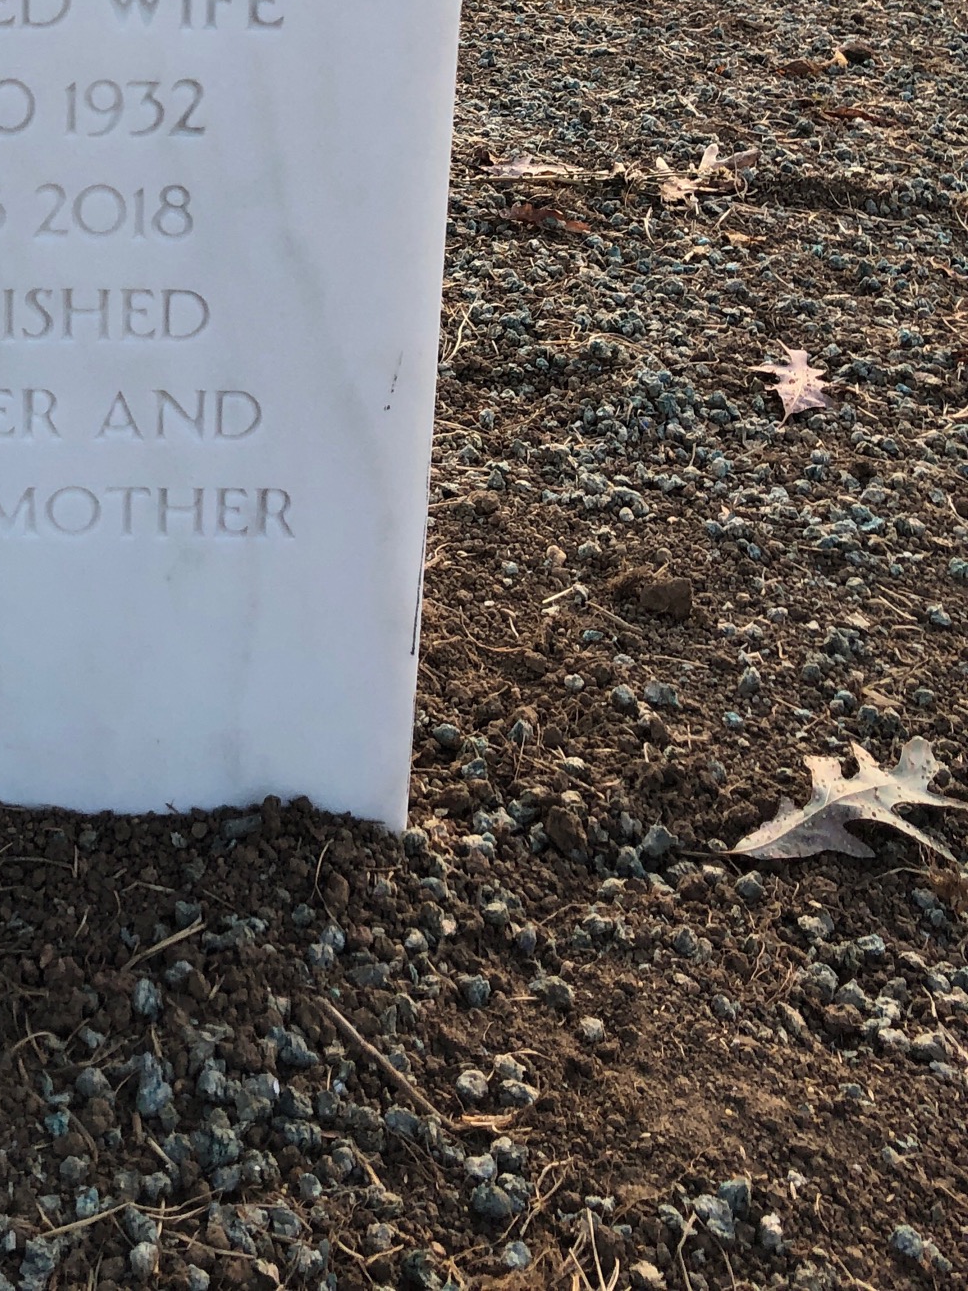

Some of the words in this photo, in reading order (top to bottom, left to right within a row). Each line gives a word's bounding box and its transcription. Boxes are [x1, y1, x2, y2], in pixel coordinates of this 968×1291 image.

[65, 79, 207, 137] 1932
[33, 183, 194, 238] 2018
[94, 389, 263, 440] AND
